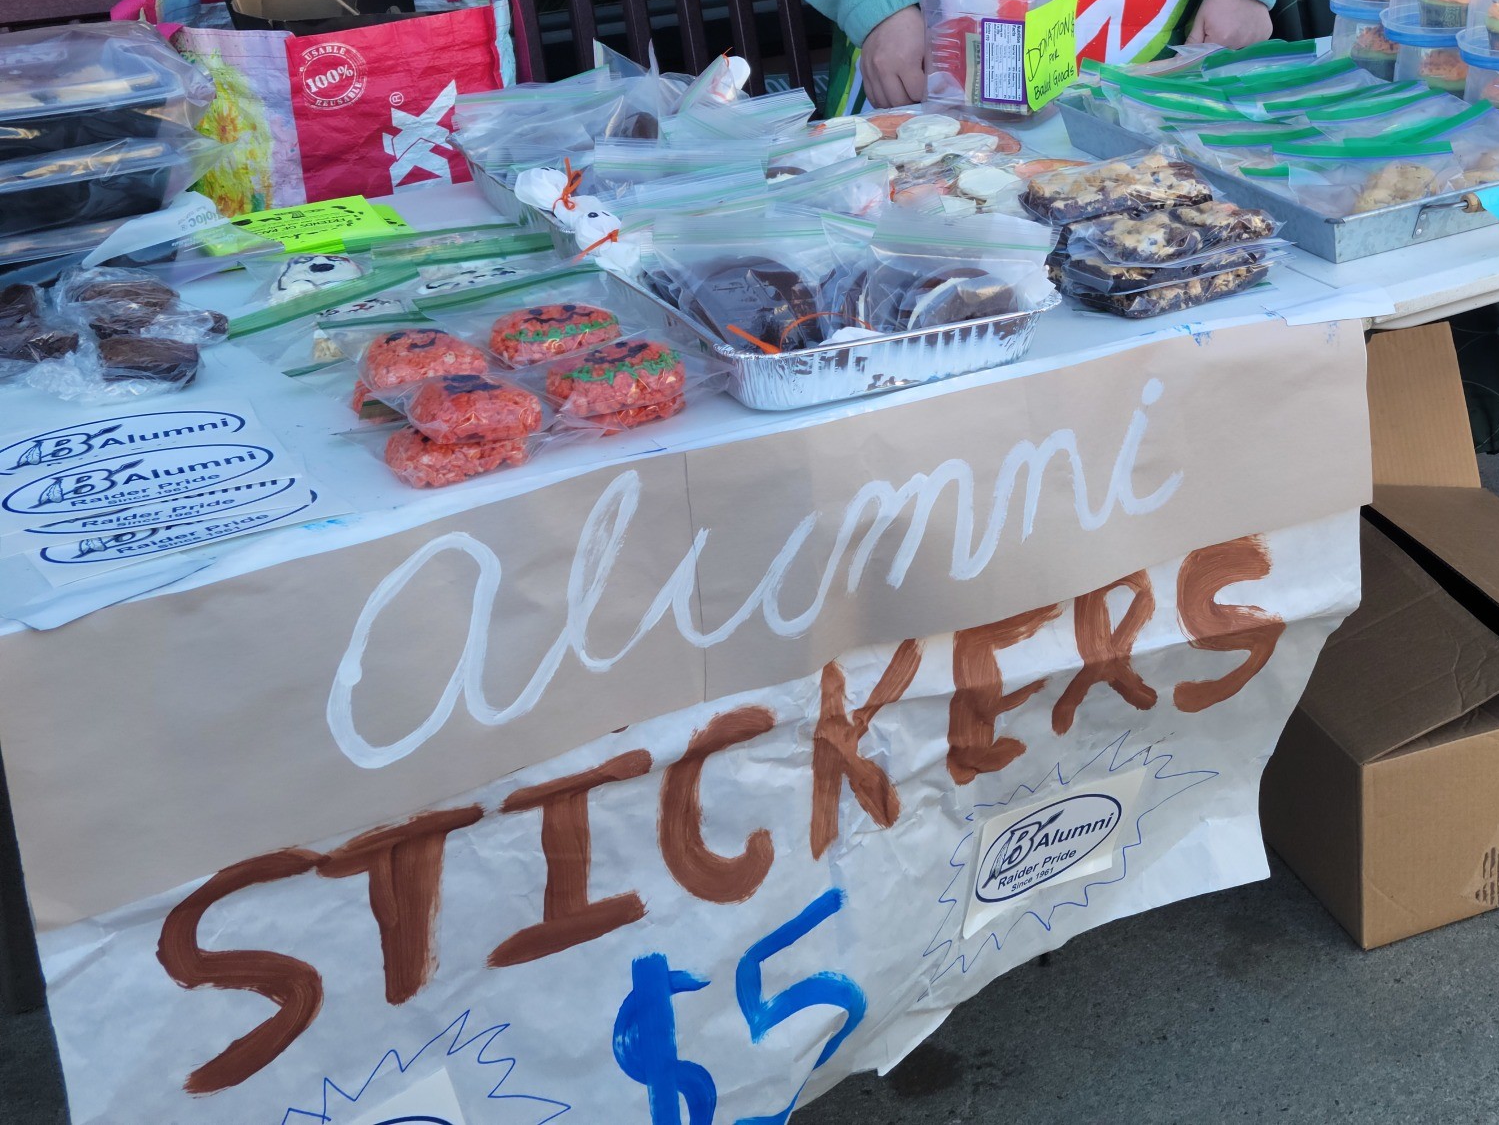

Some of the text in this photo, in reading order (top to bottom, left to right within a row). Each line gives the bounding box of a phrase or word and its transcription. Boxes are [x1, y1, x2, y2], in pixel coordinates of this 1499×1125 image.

[305, 64, 354, 93] 100%
[314, 81, 363, 107] REUSABLE
[98, 417, 230, 450] Alumni
[122, 450, 257, 486] Alumni
[70, 487, 147, 507] Raider
[157, 474, 221, 491] Pride
[107, 493, 154, 505] Since
[80, 497, 236, 528] Raider Pride
[115, 512, 270, 554] Raider Pride
[154, 532, 1287, 1093] STICKERS
[1033, 812, 1115, 853] Alumni
[997, 849, 1078, 890] Raider Pride
[1011, 867, 1055, 892] Since 1961
[611, 886, 869, 1125] $5
